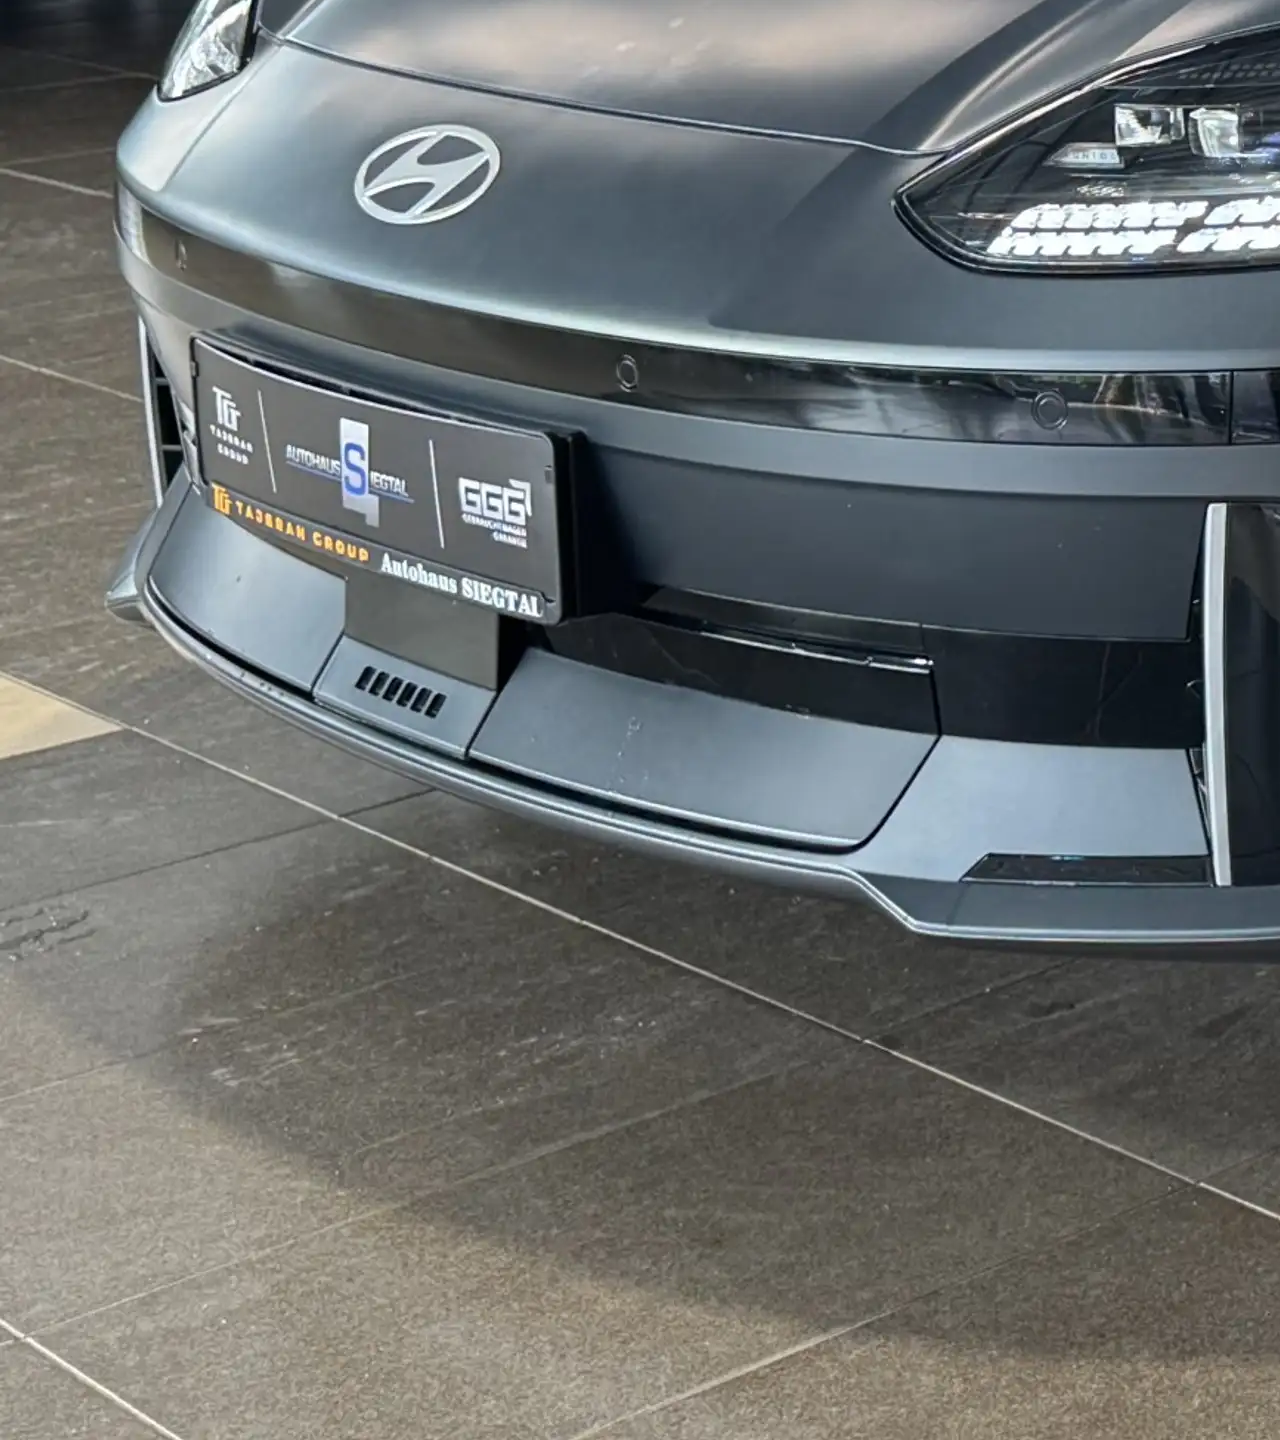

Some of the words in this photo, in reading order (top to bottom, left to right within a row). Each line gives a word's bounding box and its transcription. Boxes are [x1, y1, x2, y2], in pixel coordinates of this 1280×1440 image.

[286, 443, 341, 476] AUTOHAUS
[312, 530, 369, 562] GROUP
[380, 552, 458, 594] Autohaus
[461, 576, 543, 618] SIEGTAL
